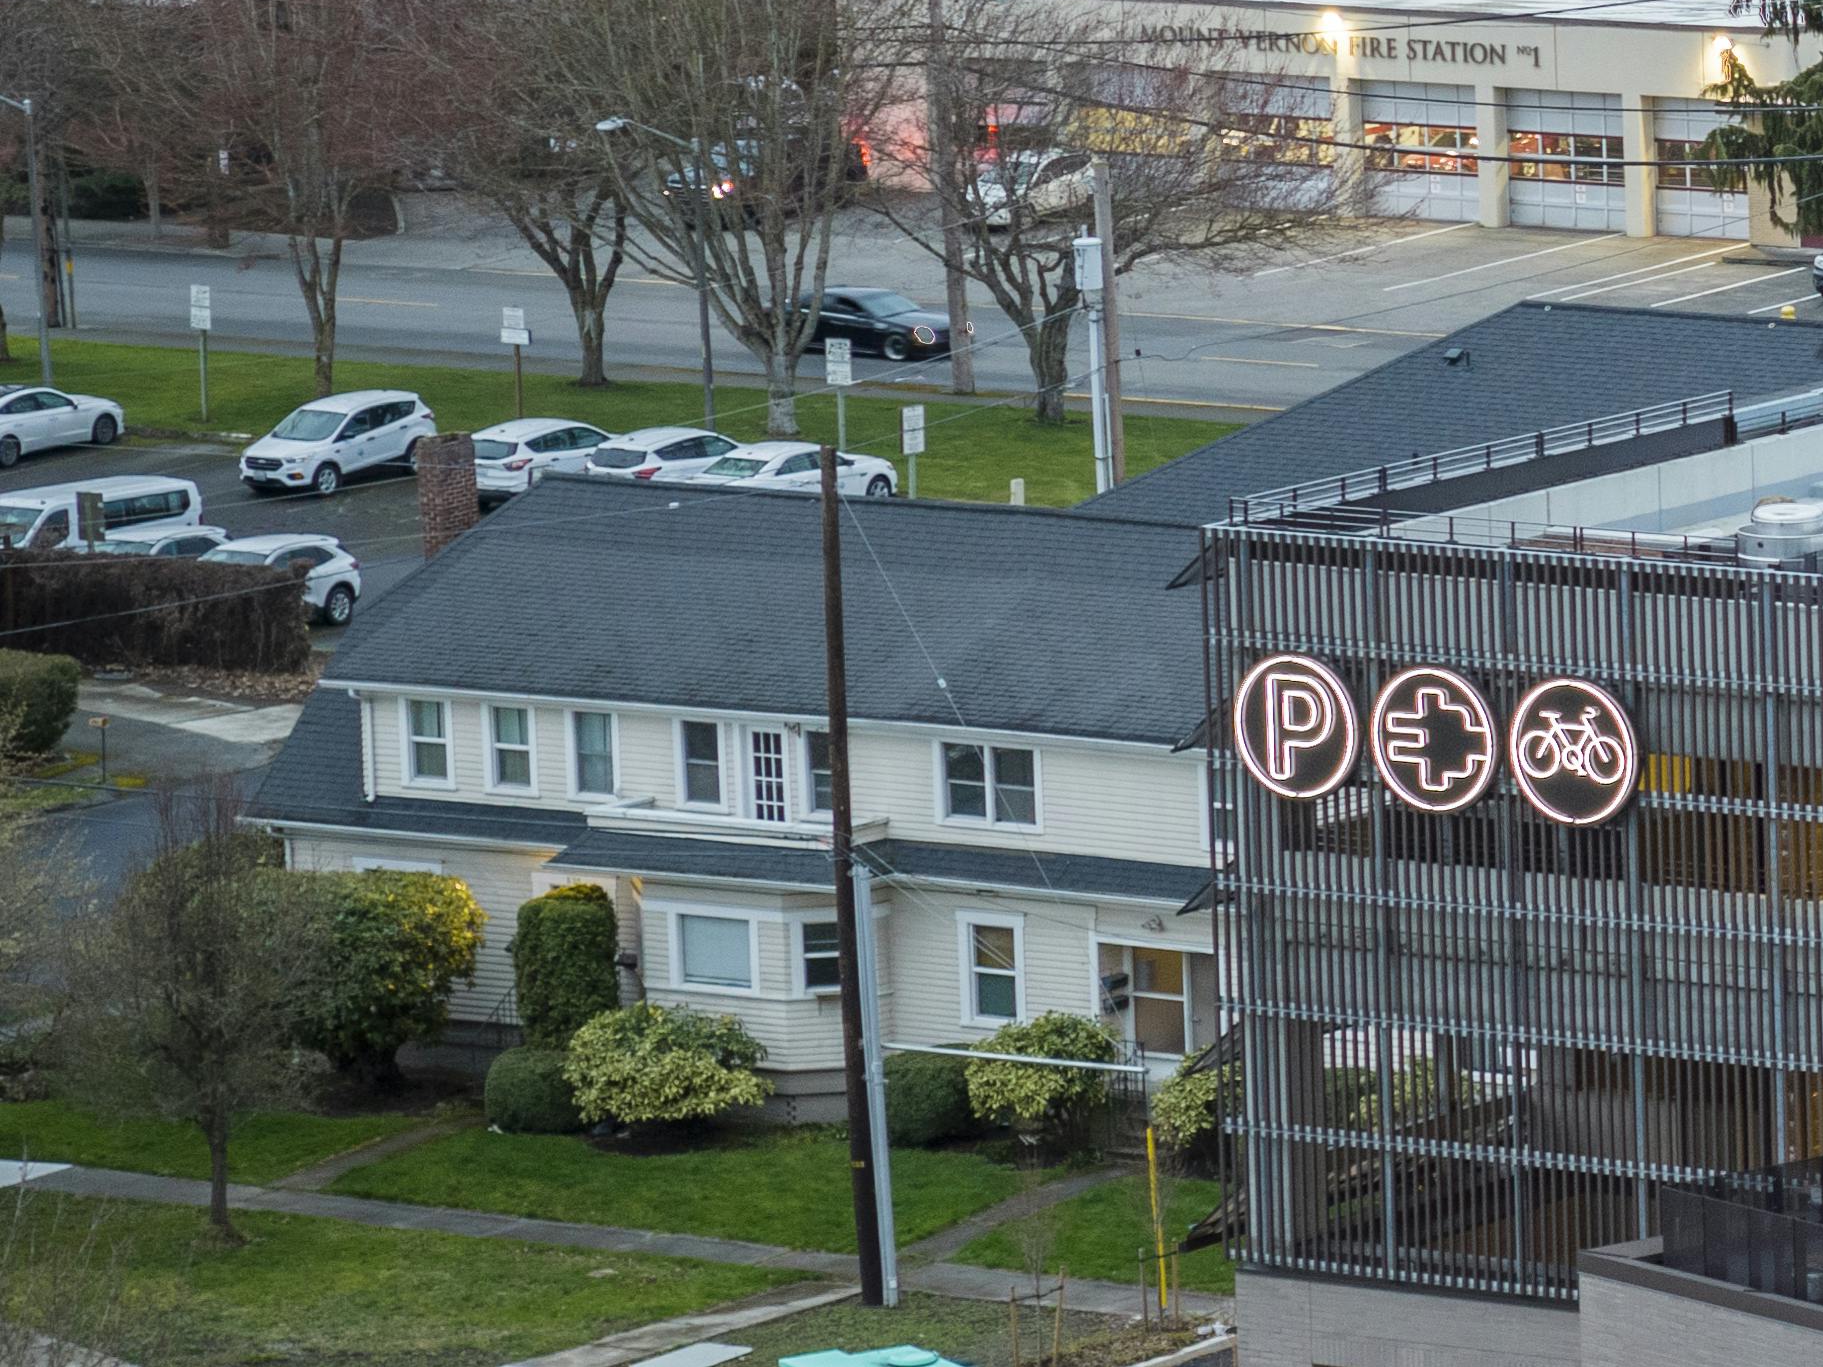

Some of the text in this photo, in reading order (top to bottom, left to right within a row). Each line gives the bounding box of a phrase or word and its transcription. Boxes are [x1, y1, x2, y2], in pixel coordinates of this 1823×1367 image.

[1141, 22, 1226, 49] MOUNT
[1238, 29, 1337, 57] VERNON
[1349, 34, 1399, 60] FIRE
[1406, 39, 1506, 66] STATION
[1265, 673, 1336, 781] P
